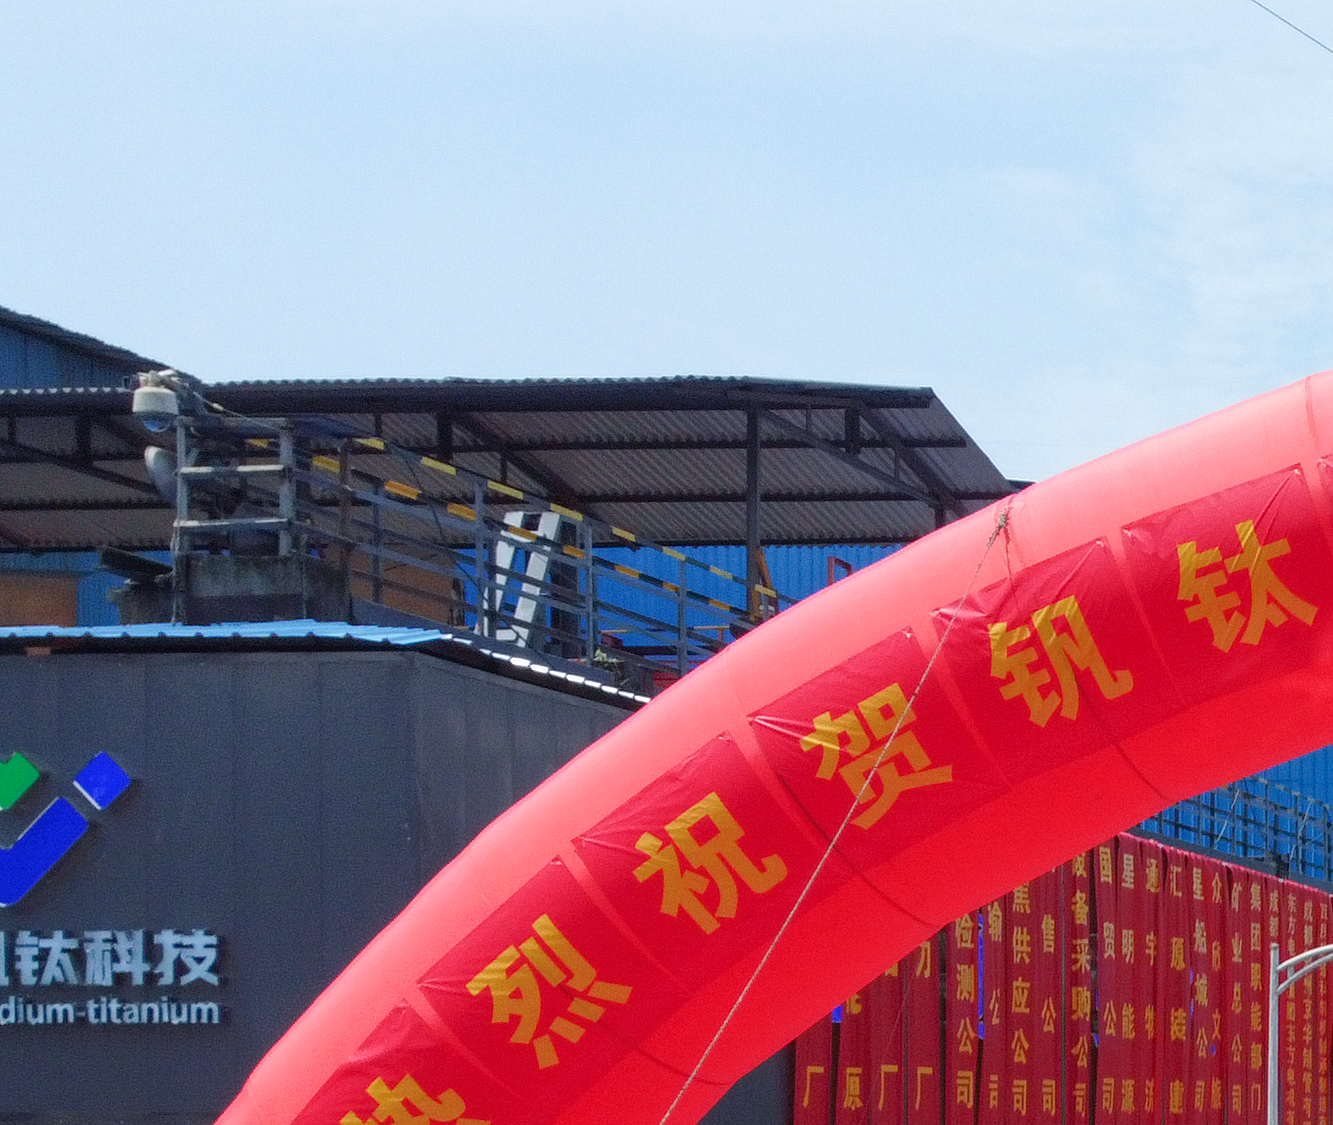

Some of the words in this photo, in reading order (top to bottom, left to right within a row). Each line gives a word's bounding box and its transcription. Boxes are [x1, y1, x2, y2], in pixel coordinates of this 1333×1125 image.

[0, 929, 219, 986] 钛科技
[879, 959, 898, 1111] 厂
[1099, 847, 1116, 1113] 国贸公司
[1121, 854, 1135, 1113] 星明能源
[1192, 867, 1208, 1112] 星船城公司
[1232, 882, 1243, 1116] 矿业总公司
[1251, 882, 1262, 1111] 集团职能部门
